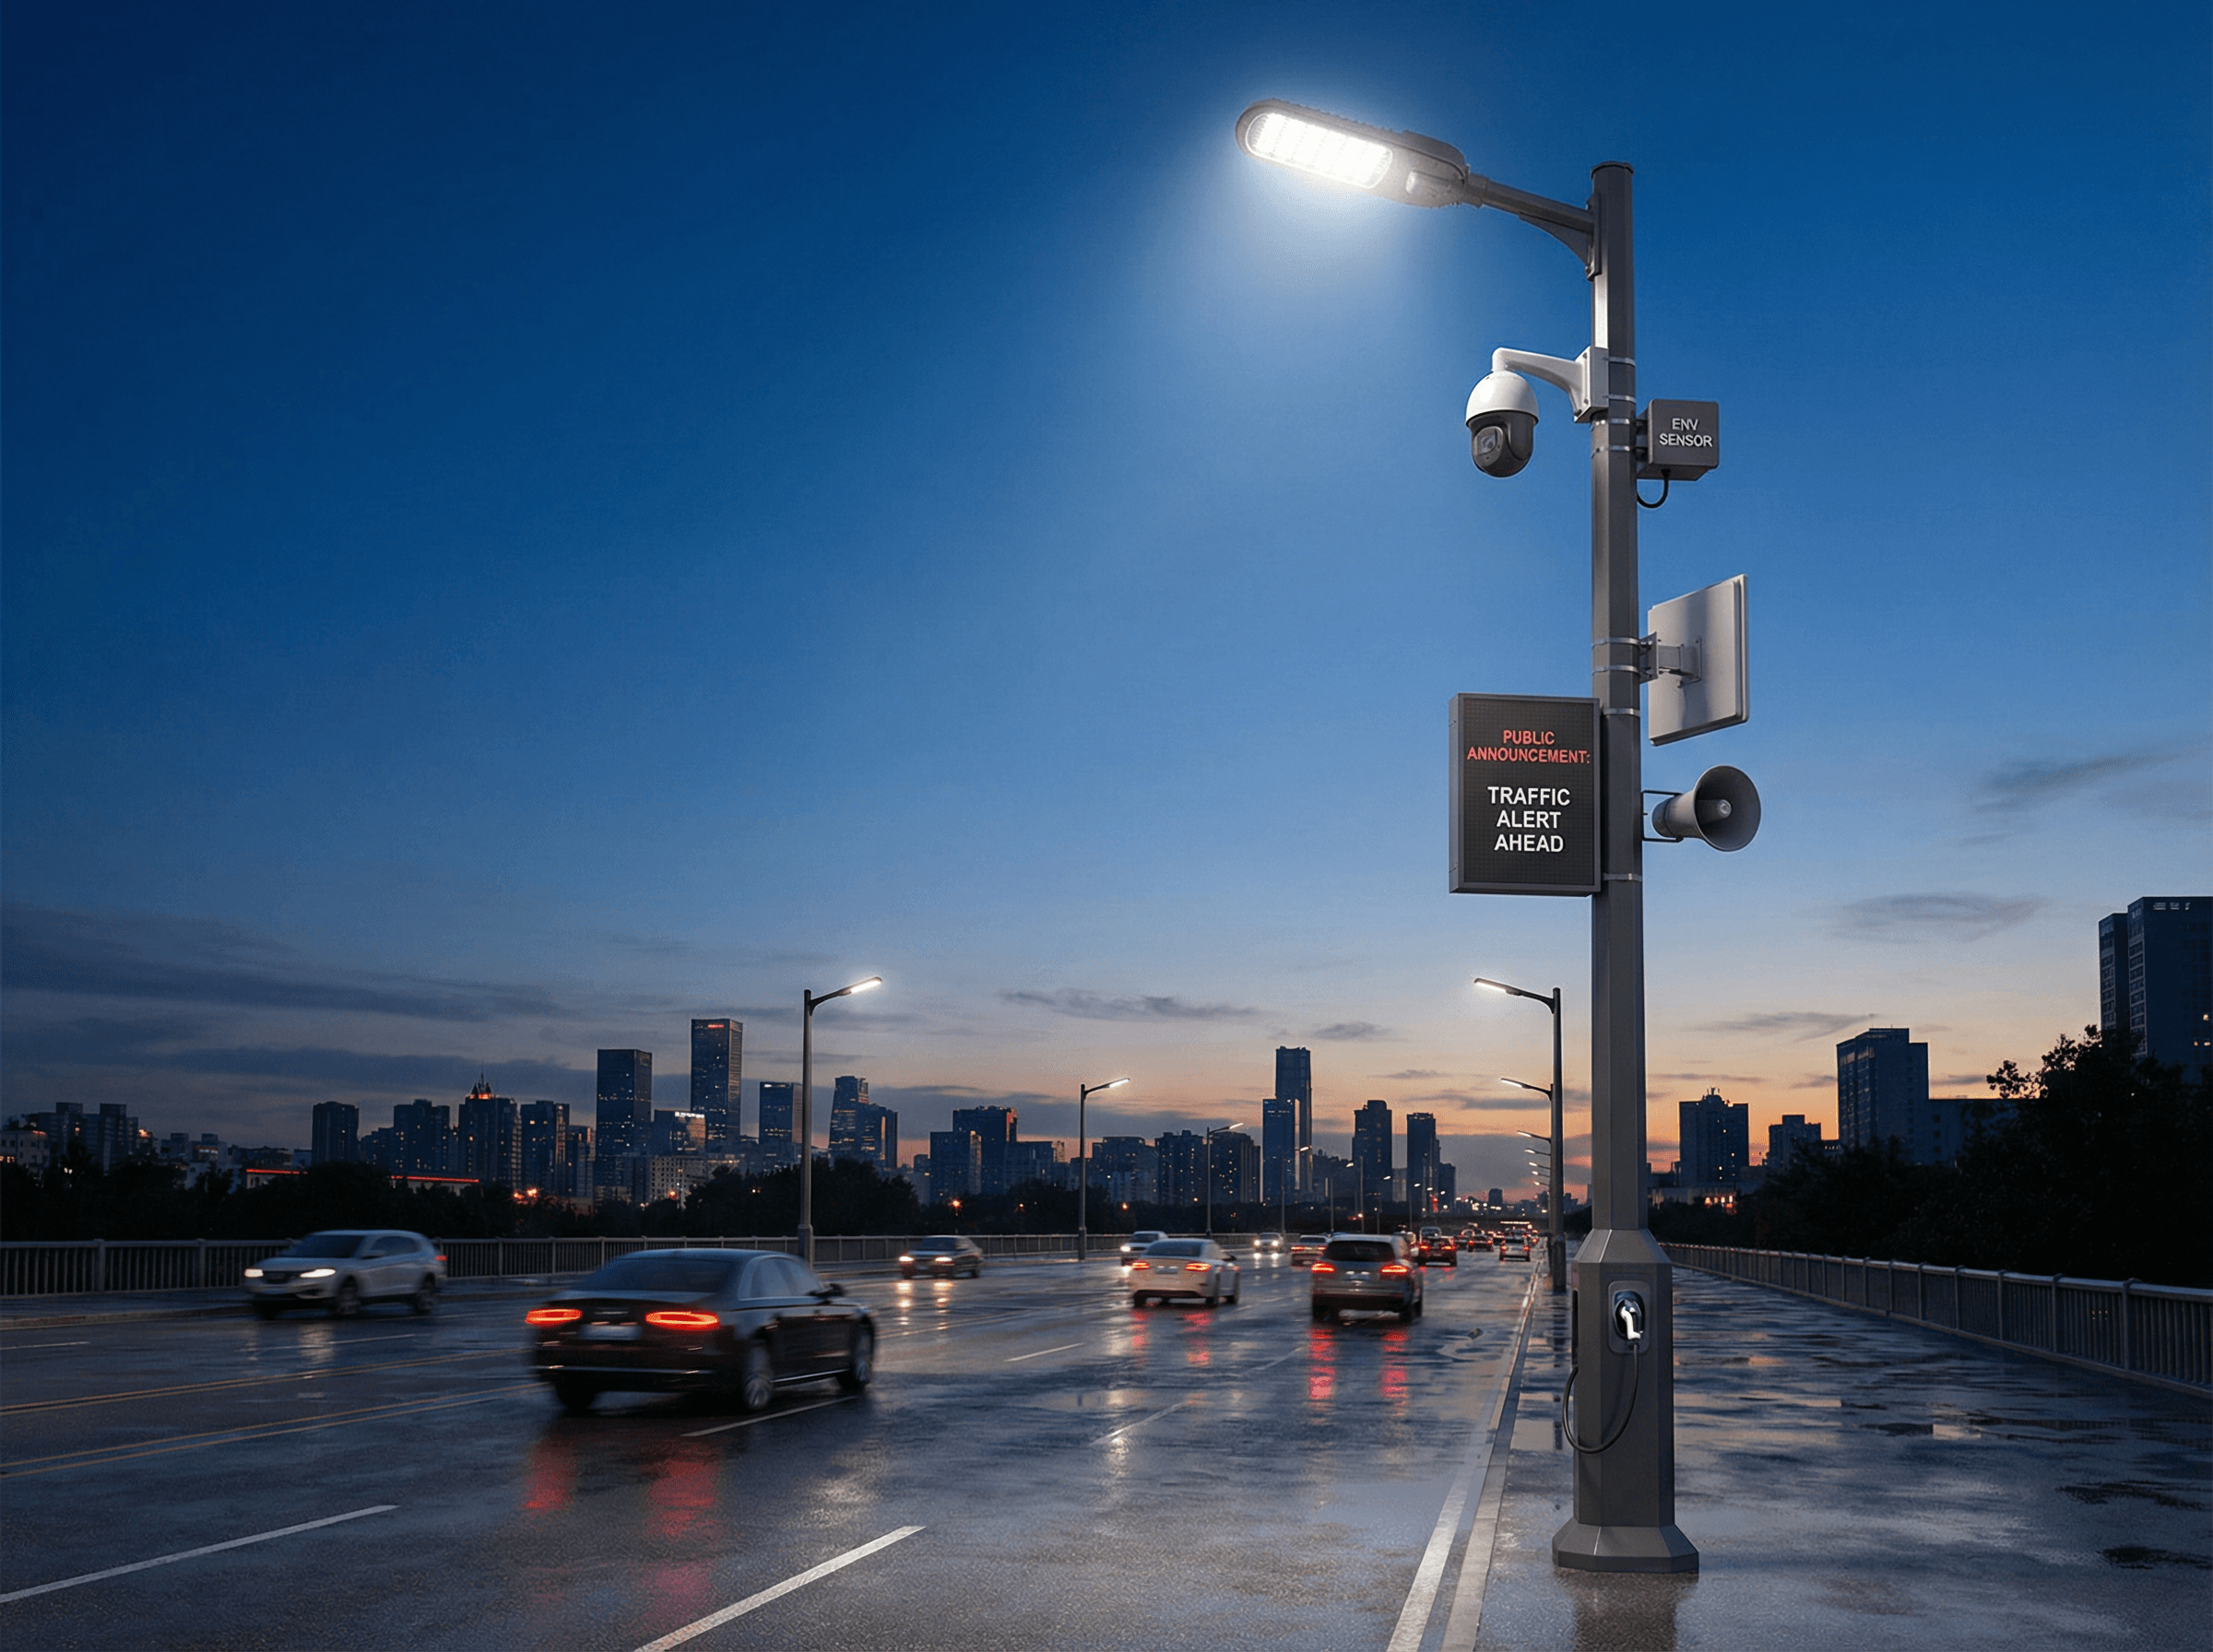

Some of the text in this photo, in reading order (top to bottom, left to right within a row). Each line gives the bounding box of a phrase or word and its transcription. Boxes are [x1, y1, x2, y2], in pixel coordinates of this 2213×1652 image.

[1672, 418, 1698, 431] ENV
[1659, 432, 1713, 447] SENSOR
[1503, 729, 1555, 745] PUBLIC
[1467, 747, 1591, 764] ANNOUNCEMENT:
[1487, 786, 1570, 806] TRAFFIC
[1497, 810, 1562, 829] ALERT
[1494, 833, 1564, 853] AHEAD
